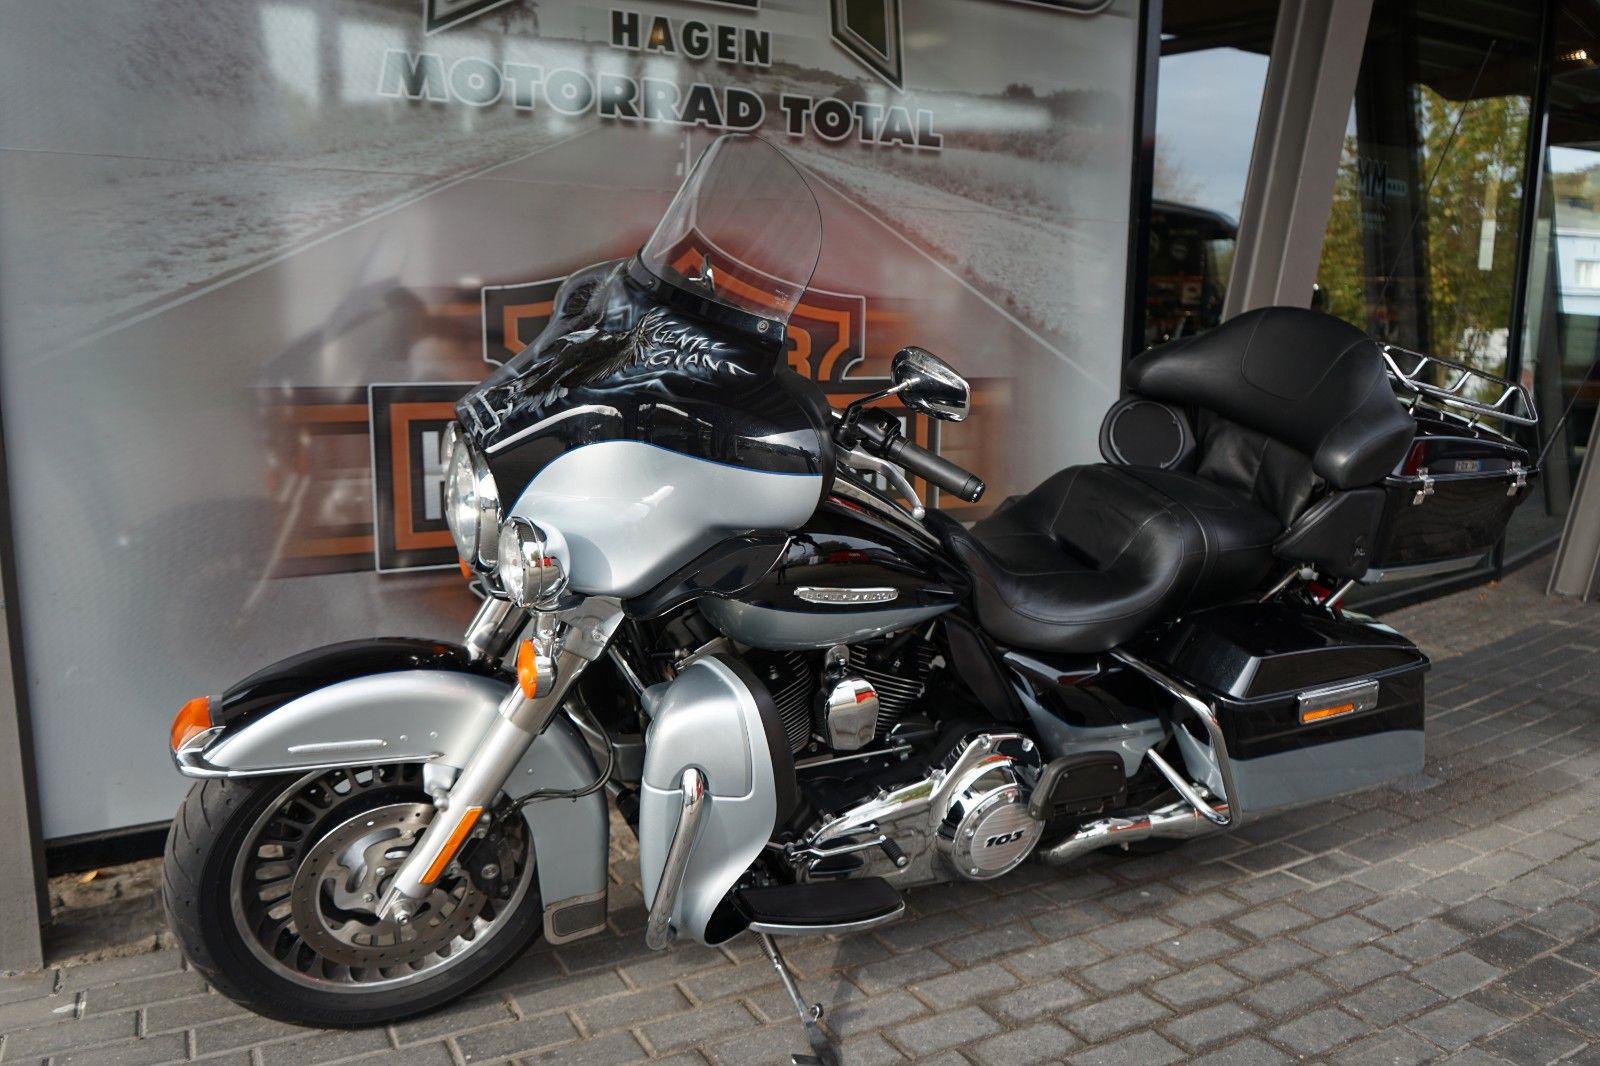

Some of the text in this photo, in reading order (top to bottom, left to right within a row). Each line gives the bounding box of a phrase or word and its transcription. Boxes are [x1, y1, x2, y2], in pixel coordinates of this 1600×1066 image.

[611, 9, 772, 66] HAGEN
[377, 49, 944, 150] MOTORRAD TOTAL
[645, 349, 757, 375] GIANT
[985, 829, 1025, 848] 103
